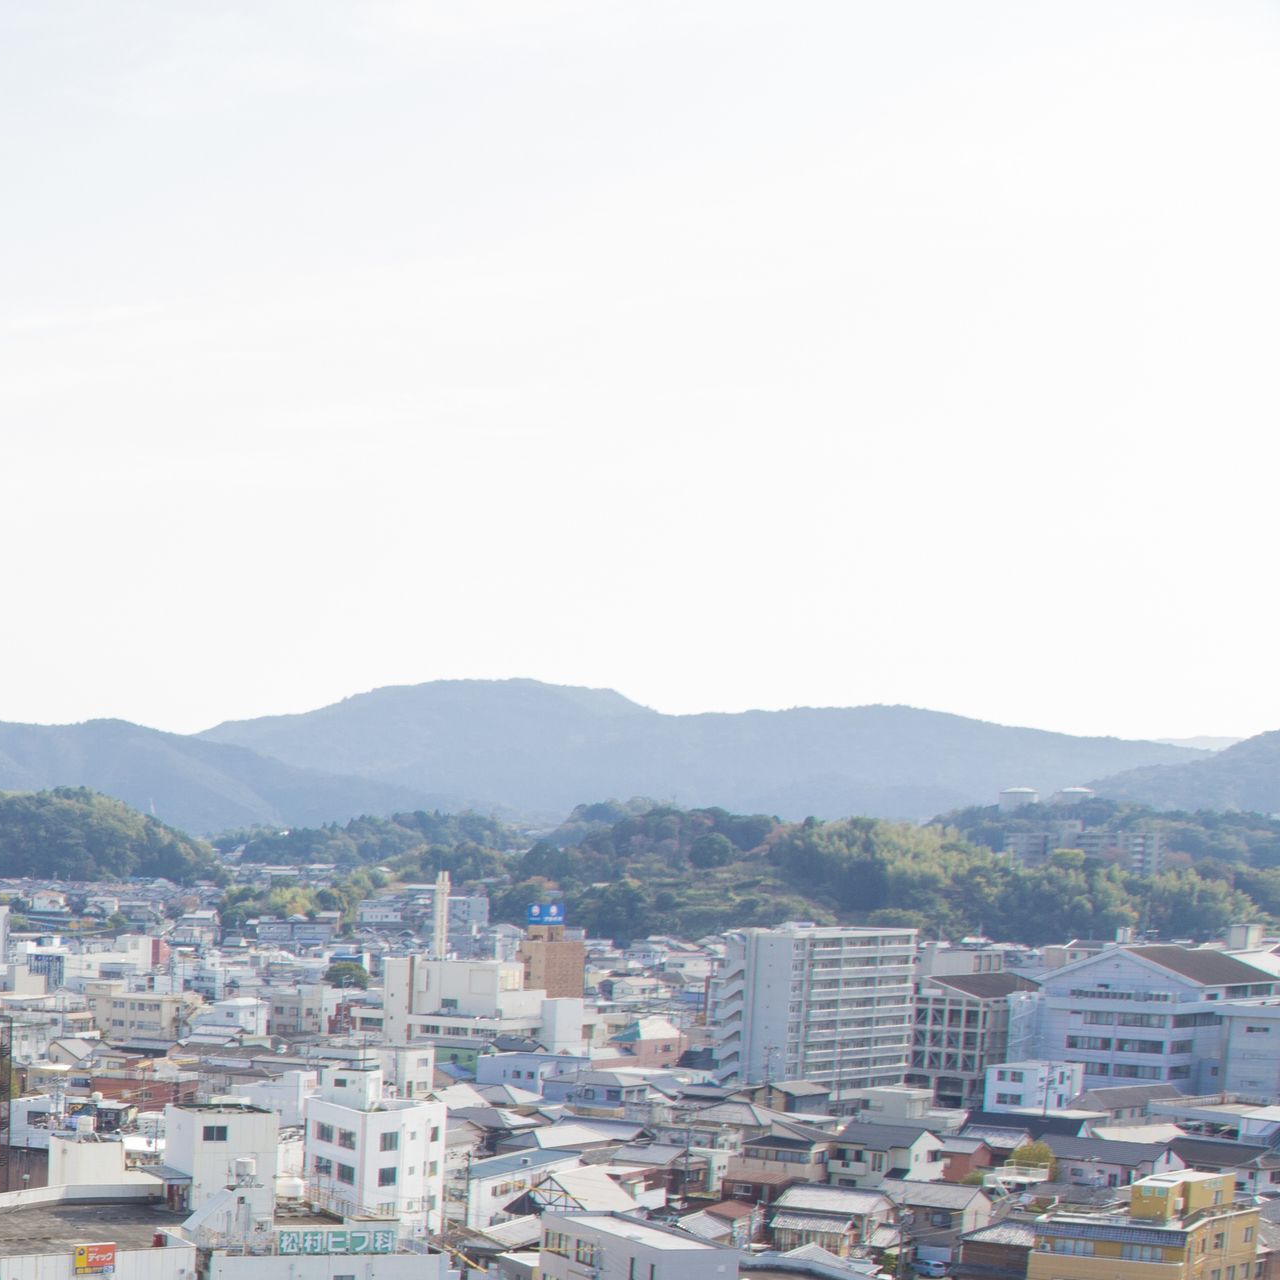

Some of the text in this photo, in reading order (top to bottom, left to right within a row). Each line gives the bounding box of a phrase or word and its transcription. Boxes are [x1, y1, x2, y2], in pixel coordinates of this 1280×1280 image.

[280, 1232, 393, 1253] 松村ヒフ科
[87, 1252, 113, 1262] ディック
